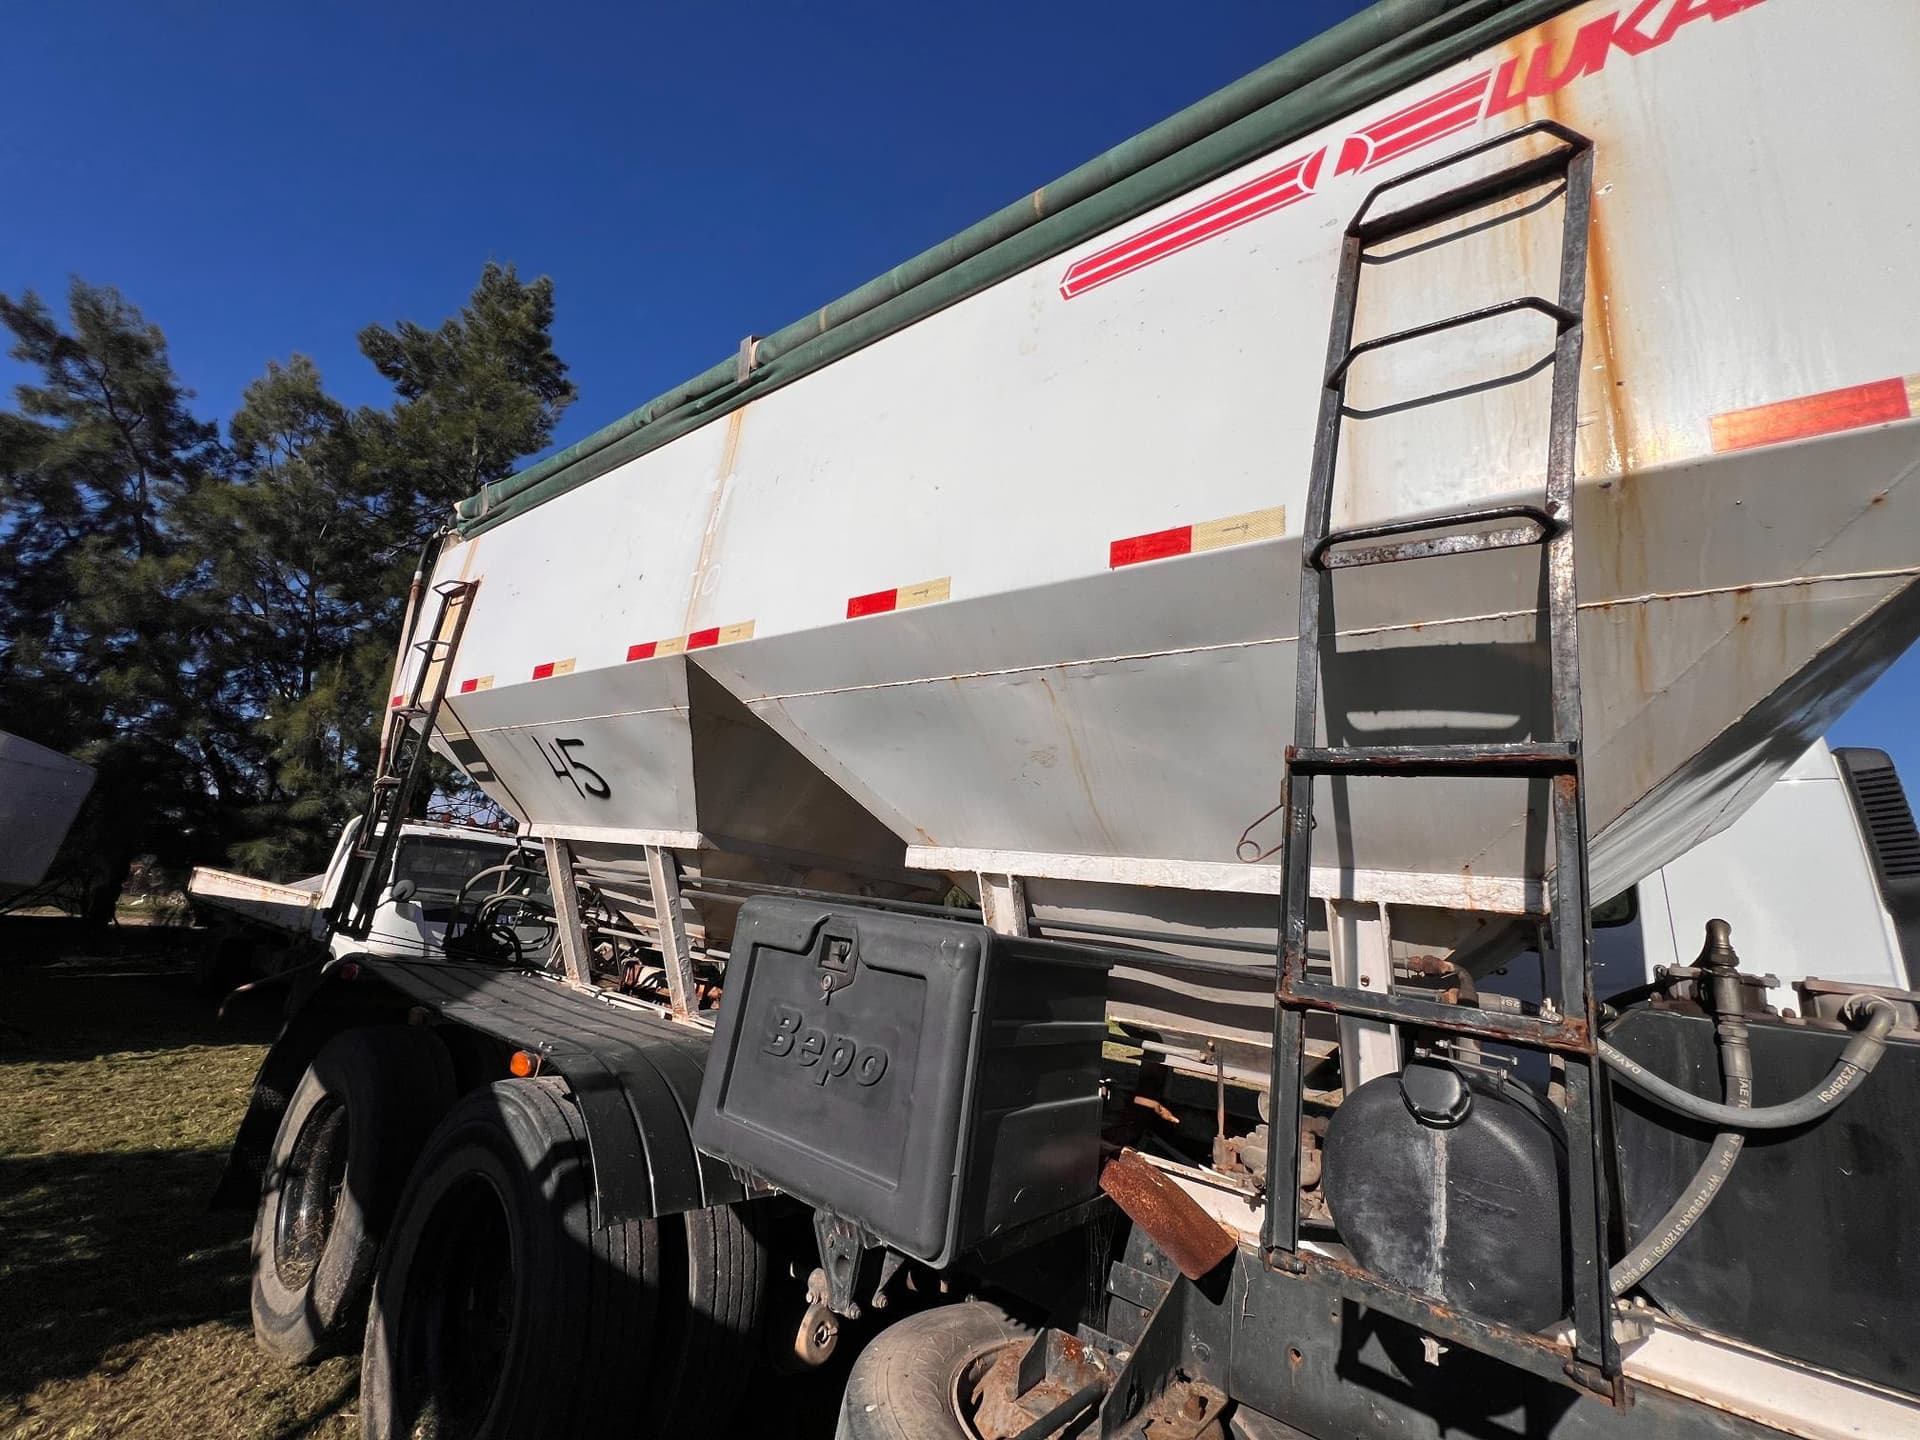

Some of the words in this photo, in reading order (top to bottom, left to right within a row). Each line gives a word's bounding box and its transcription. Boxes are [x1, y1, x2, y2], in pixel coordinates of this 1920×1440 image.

[1484, 0, 1766, 119] LUKA
[531, 735, 611, 800] 45
[762, 1004, 890, 1087] Bepo
